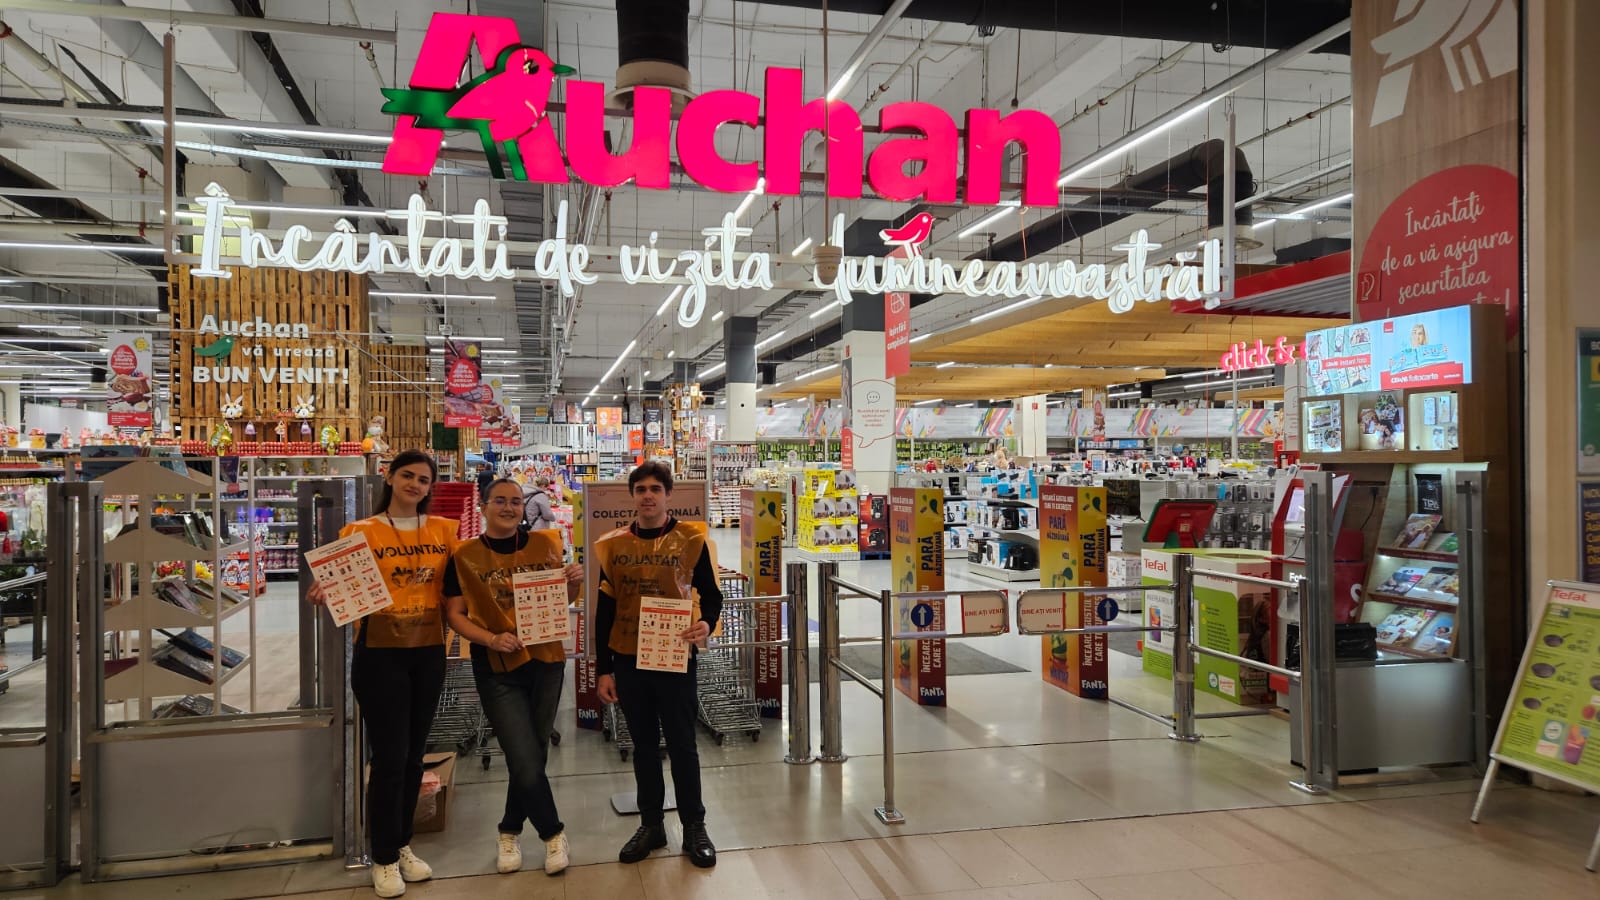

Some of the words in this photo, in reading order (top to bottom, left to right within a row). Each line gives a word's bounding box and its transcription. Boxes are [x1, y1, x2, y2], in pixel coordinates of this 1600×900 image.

[382, 12, 1062, 208] Auchan
[534, 200, 600, 297] de
[619, 211, 774, 327] vizita
[1381, 245, 1400, 276] de
[1403, 253, 1416, 268] a
[1420, 242, 1441, 264] vă
[1444, 230, 1515, 267] asigura
[1398, 261, 1492, 305] securitatea
[198, 314, 309, 338] Auchan
[242, 344, 263, 357] vă
[273, 345, 336, 358] urează
[1221, 338, 1272, 372] click
[1275, 335, 1296, 365] &
[192, 366, 249, 383] BUN
[258, 367, 349, 384] VENIT!
[756, 541, 771, 576] PARĂ
[917, 536, 933, 571] PARĂ
[1080, 533, 1095, 567] PARĂ
[1144, 559, 1168, 573] Tefal
[1552, 589, 1587, 602] Tefal
[932, 647, 941, 669] CARE
[1095, 641, 1104, 662] CARE
[920, 687, 945, 697] FANTA
[1082, 680, 1107, 689] FANTA
[578, 709, 598, 719] FANTA
